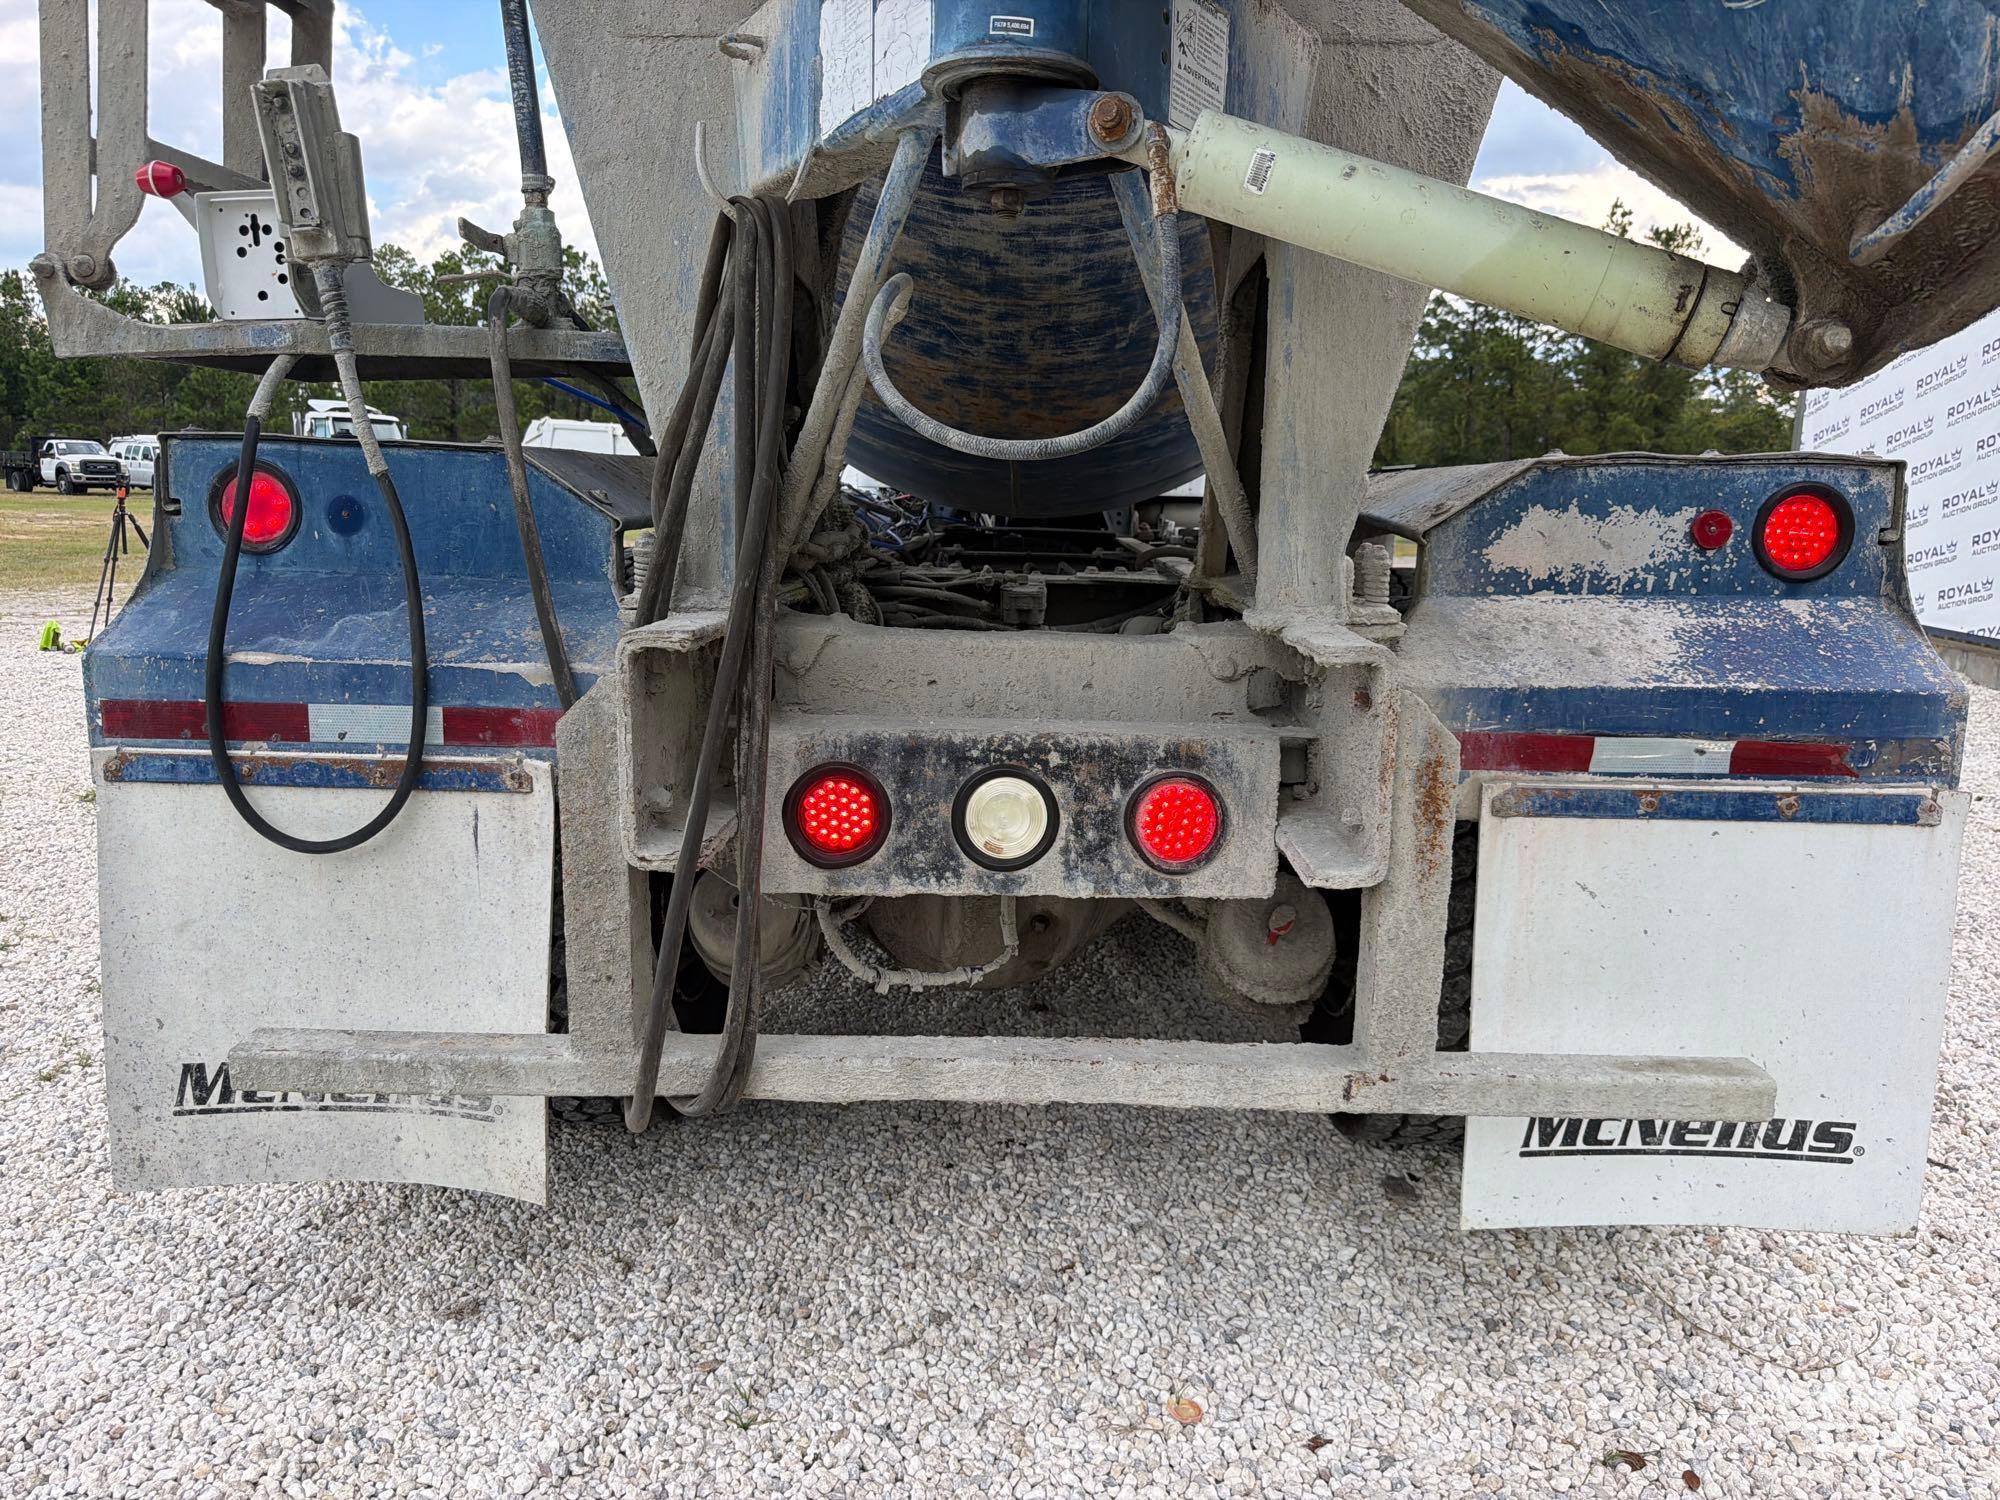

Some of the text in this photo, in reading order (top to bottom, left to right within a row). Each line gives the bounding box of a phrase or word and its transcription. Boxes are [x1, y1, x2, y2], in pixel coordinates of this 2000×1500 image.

[1982, 352, 2000, 367] AUCT
[1916, 362, 1956, 391] ROYAL
[1916, 369, 1967, 399] AUCTION GROUP
[1860, 396, 1895, 420] ROYAL
[1860, 401, 1904, 427] AUCTION GROUP
[1947, 391, 1990, 419] ROYAL
[1947, 412, 1976, 428] AUCTION
[1813, 423, 1842, 443] ROYAL
[1886, 421, 1923, 446] ROYAL
[1886, 429, 1934, 454] AUCTION GROUP
[1911, 453, 1951, 478] ROYAL
[1911, 462, 1962, 486] AUCTION GROUP
[1942, 486, 1986, 510] ROYAL
[1942, 495, 1998, 519] AUCTION GROUP
[1972, 528, 2000, 548] ROY
[1972, 543, 2000, 556] AUCTIO
[1907, 544, 1947, 565] ROYAL
[1934, 555, 1958, 567] GROUP
[1938, 582, 1981, 602] ROYAL
[1938, 593, 1993, 610] AUCTION GROUP
